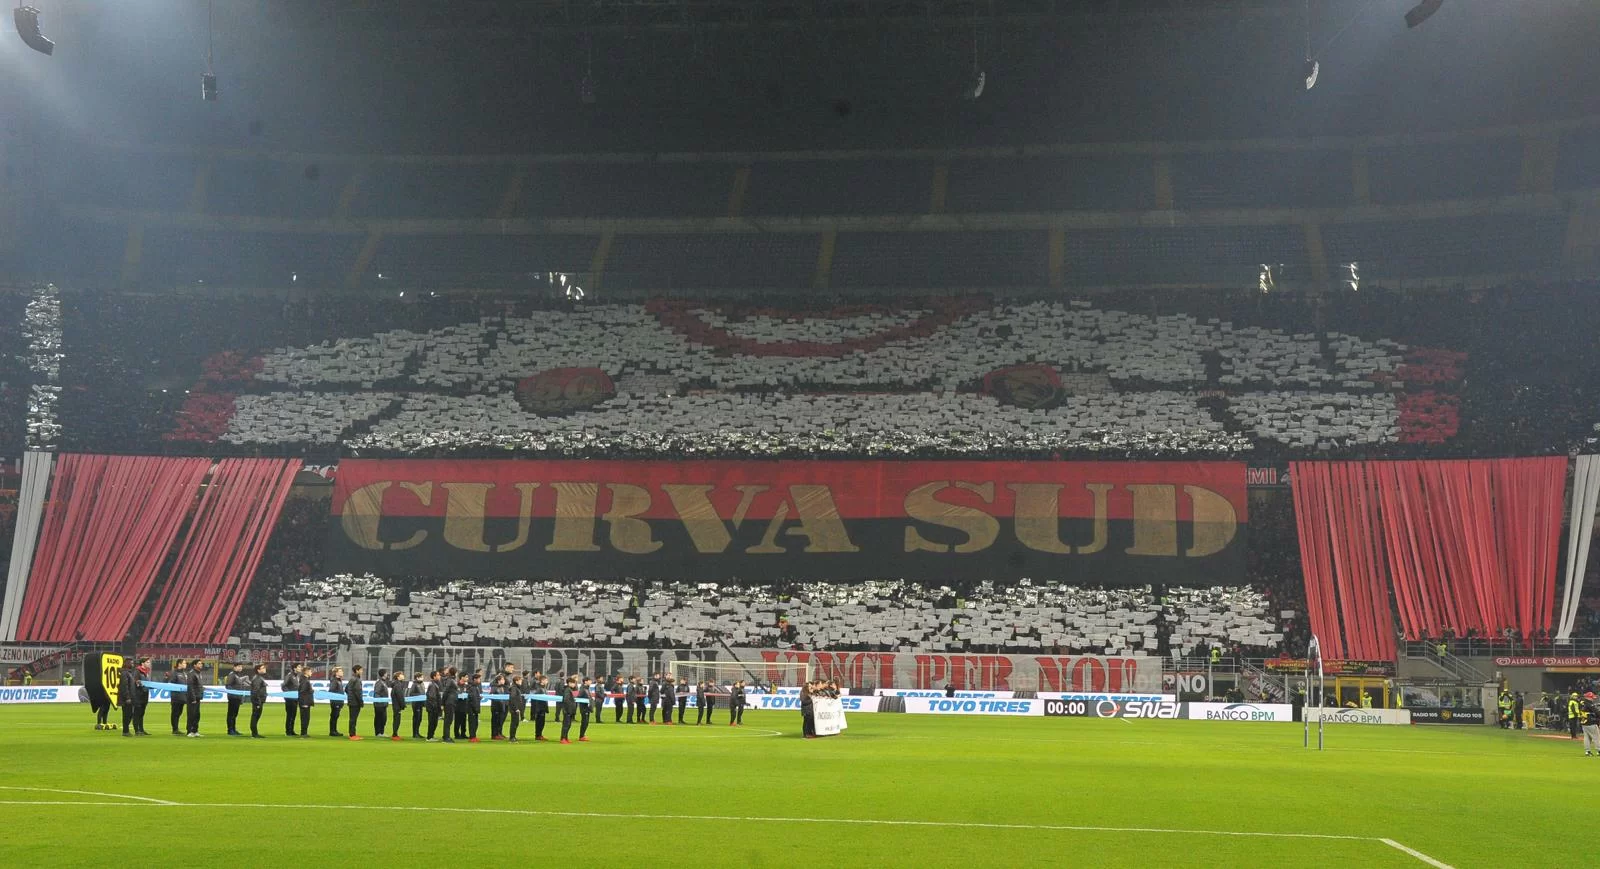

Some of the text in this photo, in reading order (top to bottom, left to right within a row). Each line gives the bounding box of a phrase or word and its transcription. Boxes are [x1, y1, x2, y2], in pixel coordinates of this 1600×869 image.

[341, 480, 1238, 558] CURVA SUD
[104, 666, 121, 689] 105
[761, 651, 897, 689] VINCI
[915, 654, 1014, 692] PER
[1035, 656, 1138, 694] NOI!
[23, 688, 59, 700] TIRES
[928, 699, 1032, 713] TOYO TIRES
[1047, 701, 1086, 715] 00:00
[1206, 710, 1275, 721] BANCO BPM
[1322, 713, 1382, 725] BANCO BPM
